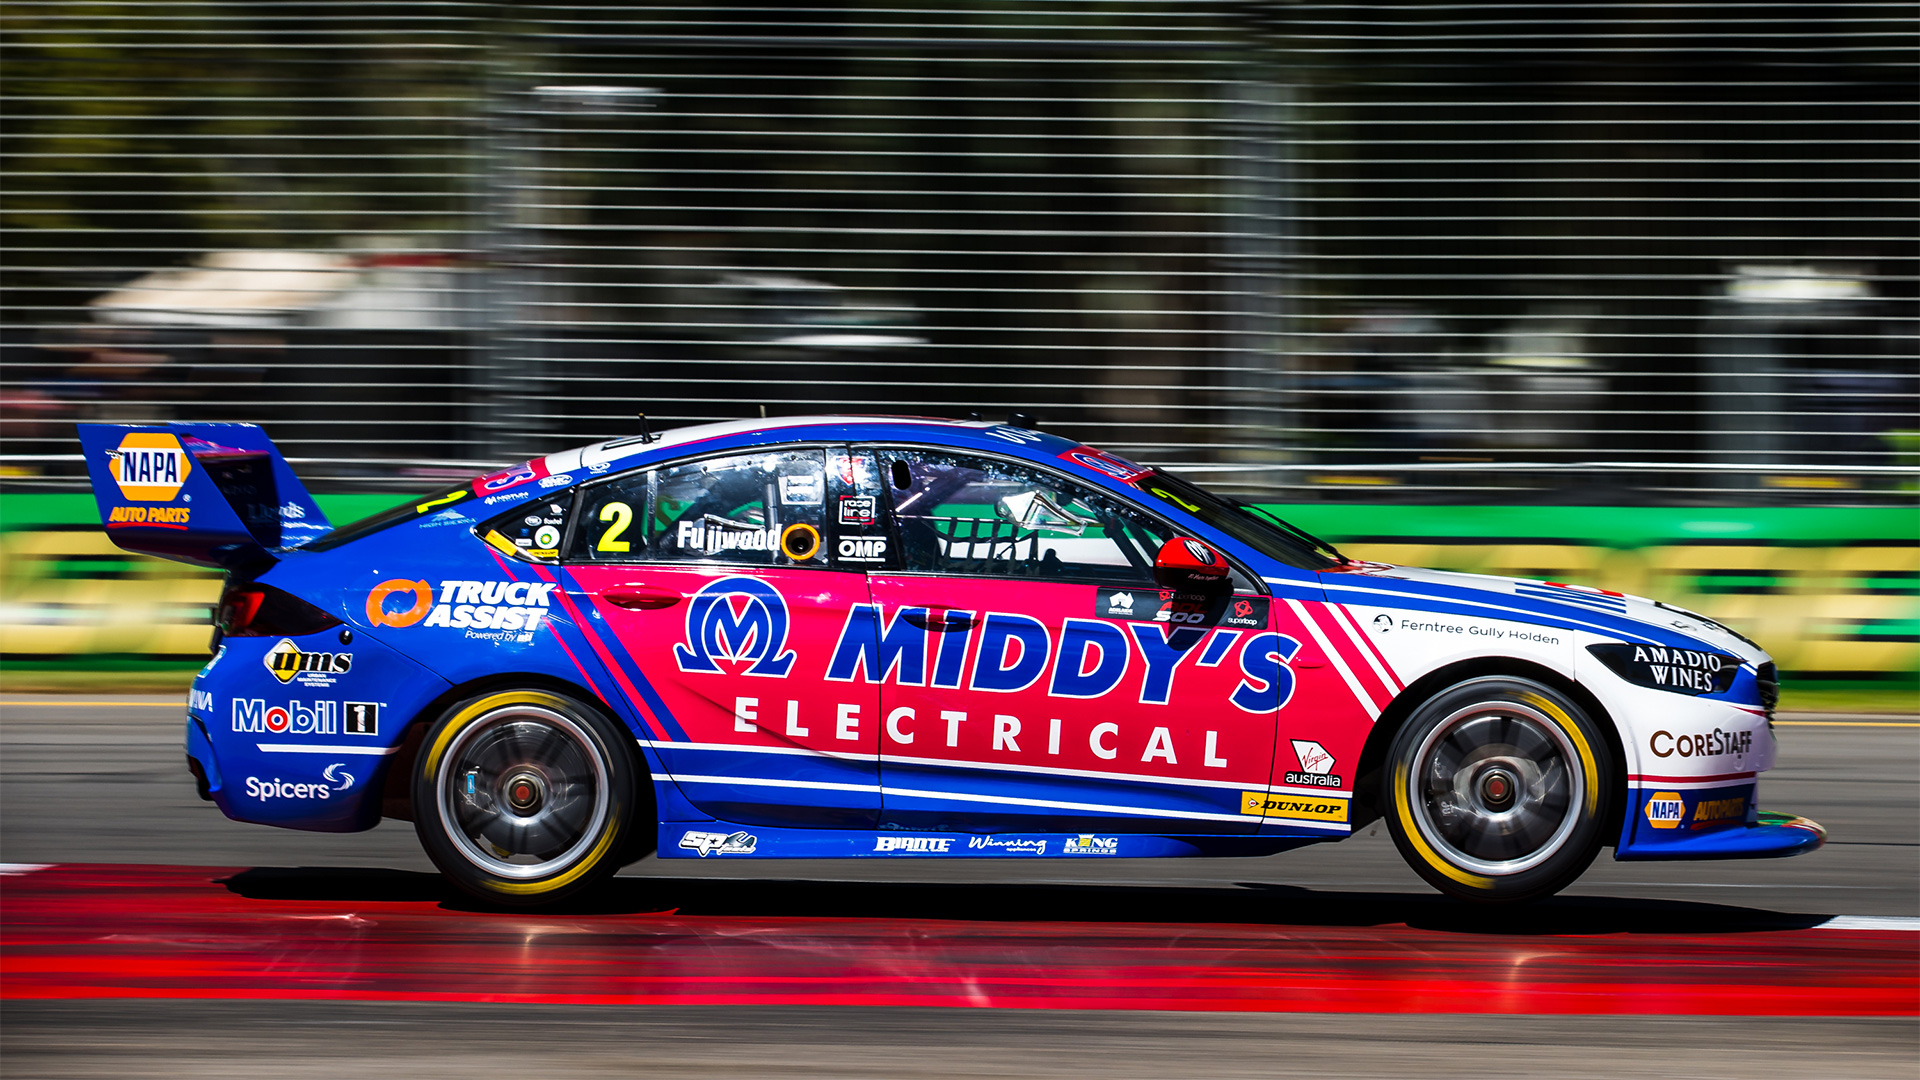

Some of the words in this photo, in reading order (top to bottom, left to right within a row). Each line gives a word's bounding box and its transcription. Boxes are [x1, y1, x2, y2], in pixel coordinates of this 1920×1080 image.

[124, 451, 178, 482] NAPA
[109, 506, 147, 522] AUTO
[147, 507, 191, 523] PARTS
[843, 506, 871, 518] line
[597, 501, 633, 553] 2
[677, 520, 783, 553] Fujiwood
[838, 540, 887, 558] OMP
[438, 580, 558, 607] TRUCK
[423, 604, 549, 631] ASSIST
[1152, 610, 1206, 624] 500
[1227, 617, 1258, 626] superloop
[465, 630, 504, 641] Powered
[503, 630, 518, 642] by
[1401, 619, 1464, 634] Ferntree
[1468, 625, 1505, 639] Gully
[1508, 630, 1560, 646] Holden
[272, 651, 353, 675] ums
[823, 602, 1304, 715] MIDDY'S
[1633, 645, 1722, 673] AMADIO
[1649, 664, 1714, 692] WINES
[232, 697, 338, 735] Mobil
[733, 696, 1228, 769] ELECTRICAL
[1301, 746, 1329, 771] Virgin
[246, 776, 331, 802] Spicers
[1286, 773, 1342, 787] australia
[1261, 800, 1342, 815] DUNLOP
[1651, 801, 1680, 819] NAPA
[873, 836, 956, 852] BIANTE
[968, 835, 1048, 855] Winning
[1063, 847, 1117, 855] SPRINGS
